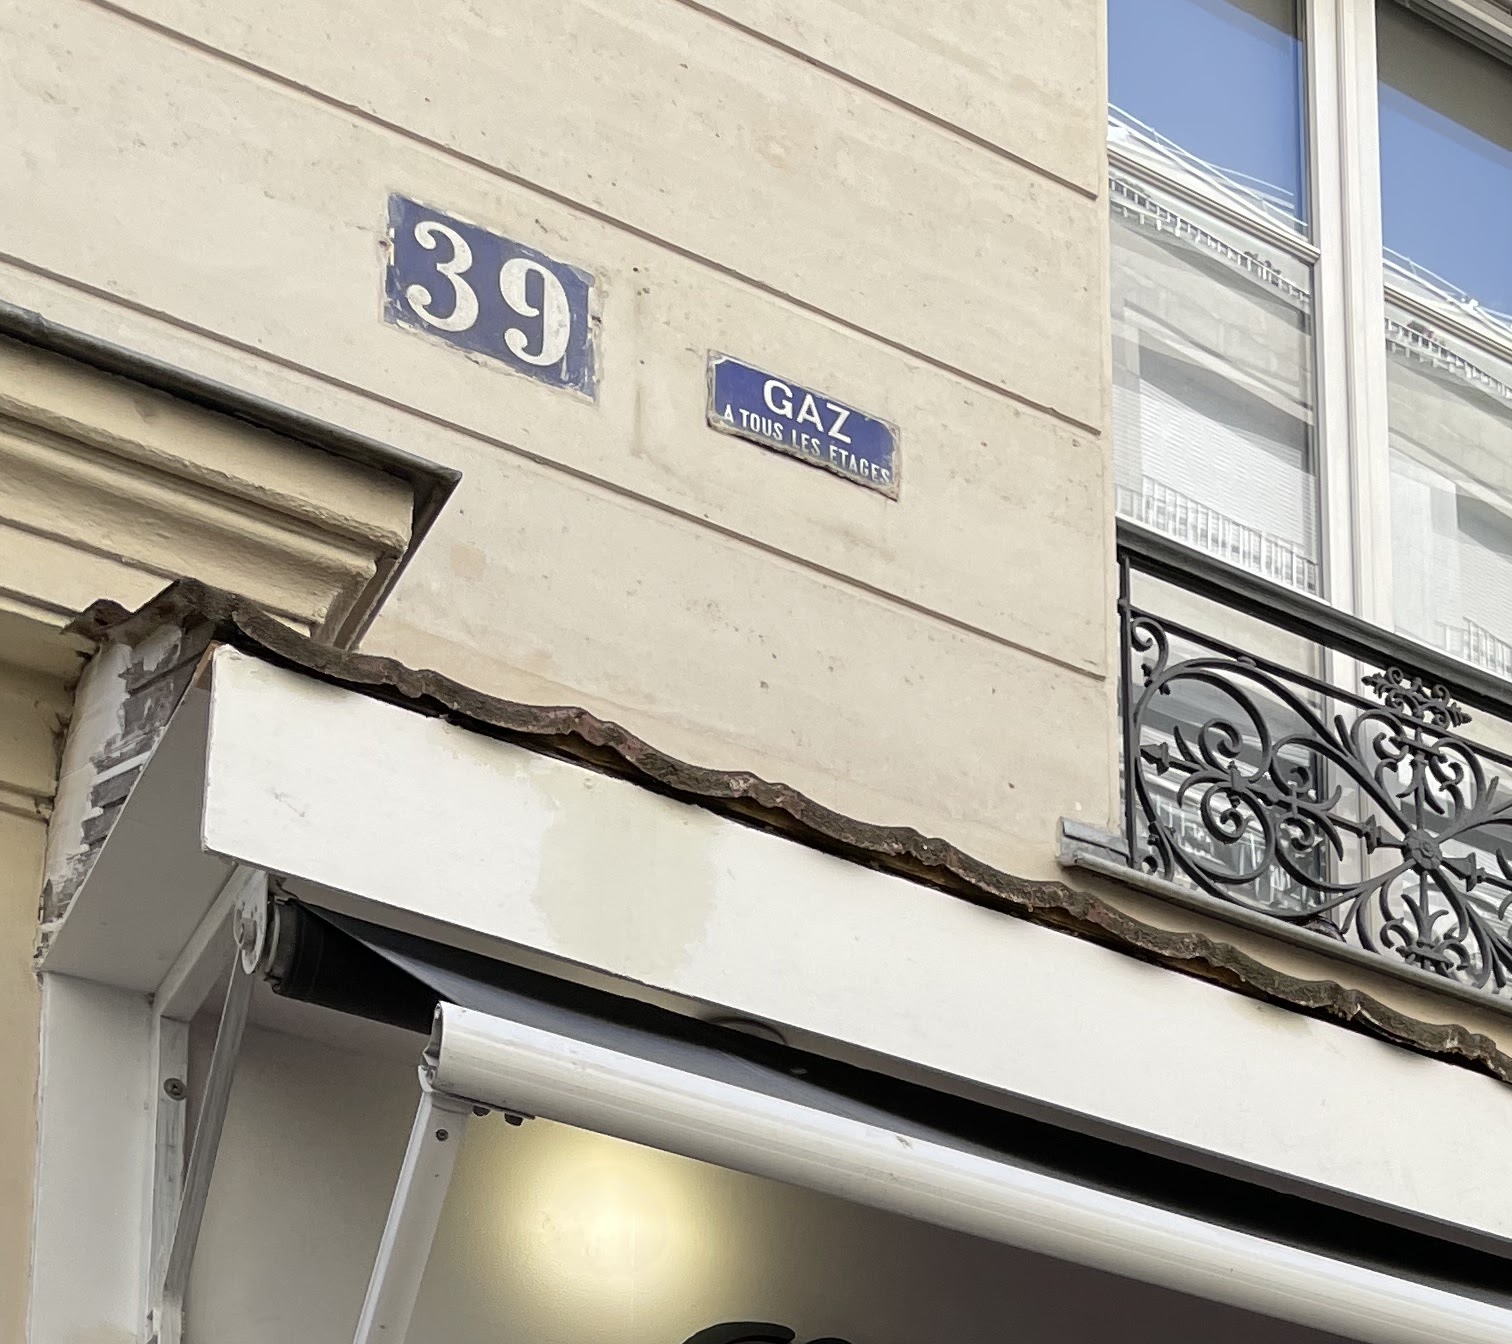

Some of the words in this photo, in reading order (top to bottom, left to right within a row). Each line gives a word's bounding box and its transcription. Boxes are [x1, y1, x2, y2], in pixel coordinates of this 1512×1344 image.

[405, 220, 571, 368] 39
[724, 404, 734, 423] A
[739, 409, 783, 441] TOUS
[791, 429, 820, 457] LES
[764, 379, 851, 444] GAZ
